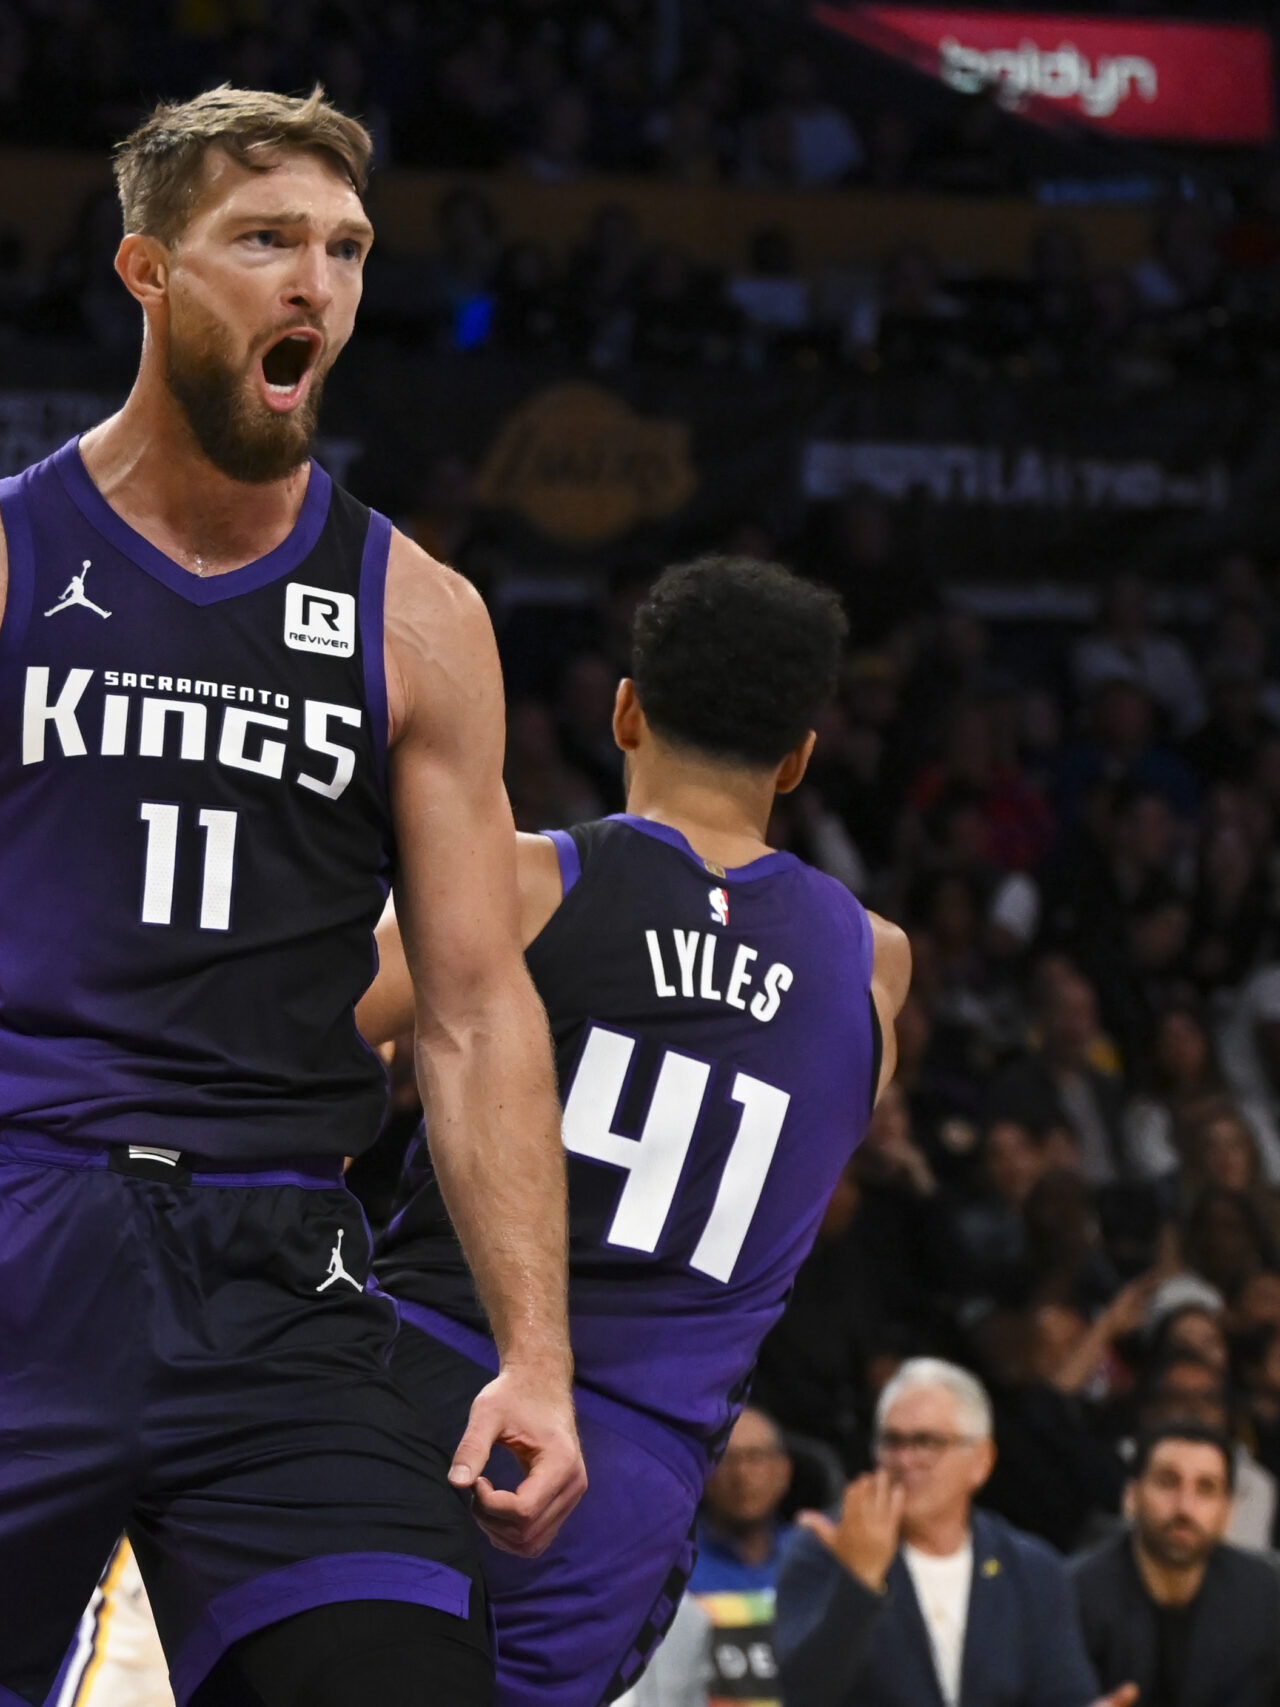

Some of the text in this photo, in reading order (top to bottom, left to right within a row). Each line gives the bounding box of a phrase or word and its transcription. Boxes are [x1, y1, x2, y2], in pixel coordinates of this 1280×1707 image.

[289, 631, 349, 650] REVIVER
[301, 593, 340, 632] R
[22, 665, 362, 801] KINGS
[103, 670, 290, 710] SACRAMENTO
[140, 802, 238, 931] 11
[644, 928, 795, 1023] LYLES
[560, 1026, 791, 1284] 41
